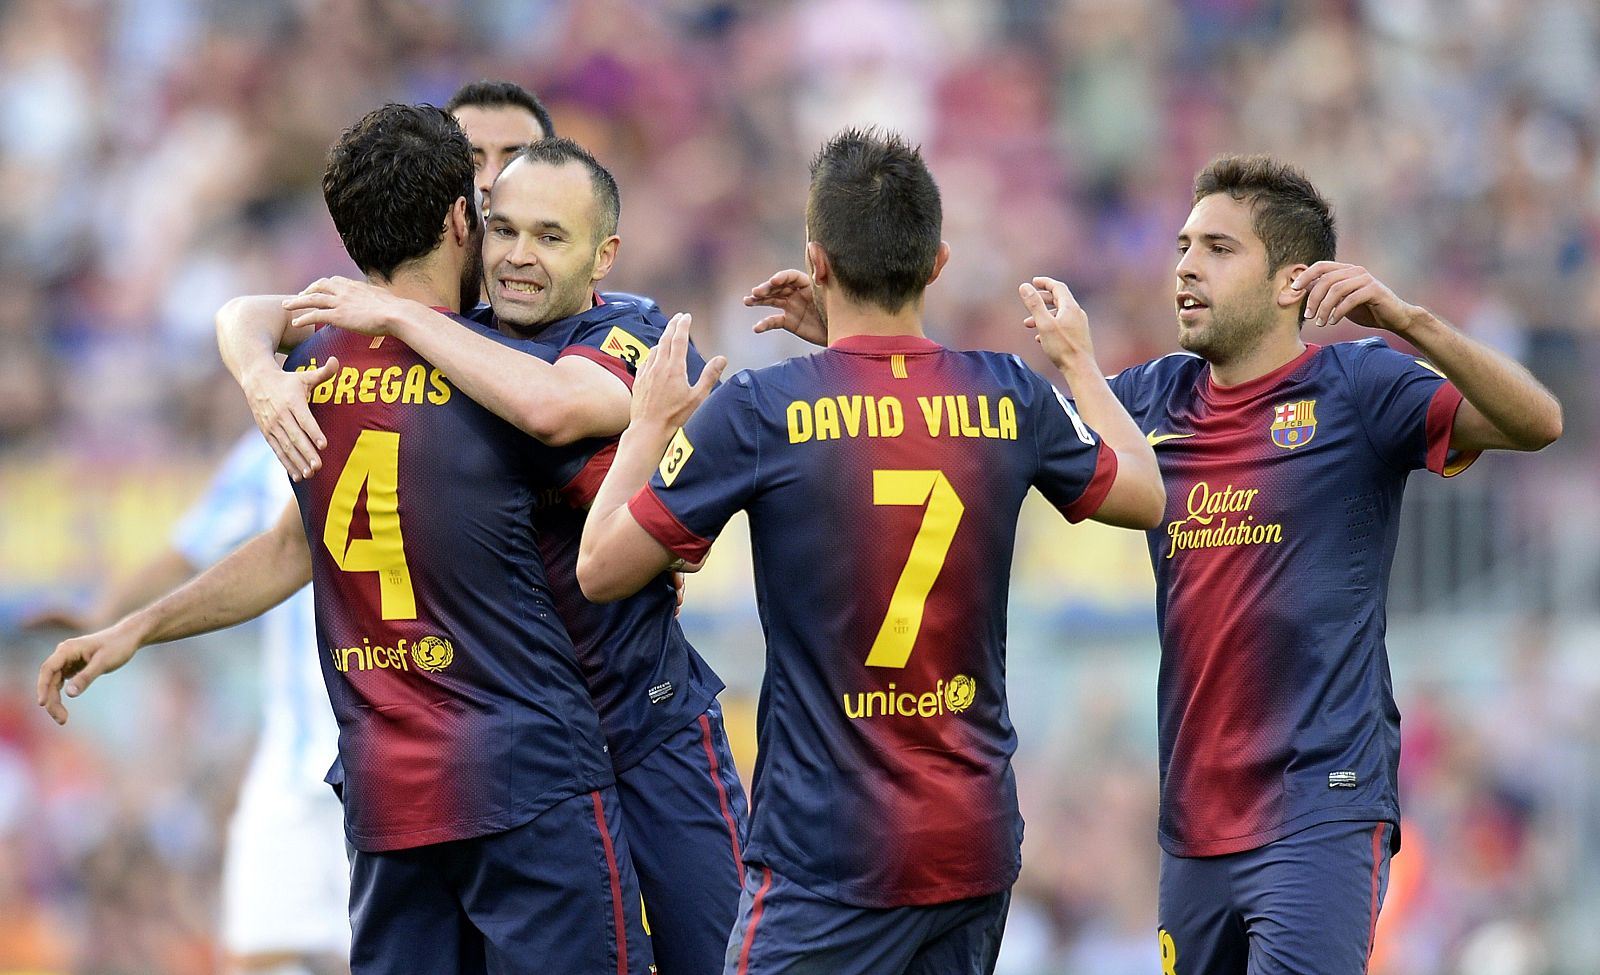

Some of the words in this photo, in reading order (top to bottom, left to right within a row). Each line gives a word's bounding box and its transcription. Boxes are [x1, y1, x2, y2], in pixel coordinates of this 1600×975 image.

[295, 357, 451, 405] BREGAS
[786, 395, 904, 444] DAVID
[917, 394, 1018, 440] VILLA
[667, 447, 683, 474] 3
[323, 429, 417, 620] 4
[1186, 481, 1259, 525] Qatar
[1165, 515, 1283, 559] Foundation
[864, 469, 965, 669] 7
[329, 637, 409, 672] unicef
[843, 678, 944, 719] unicef
